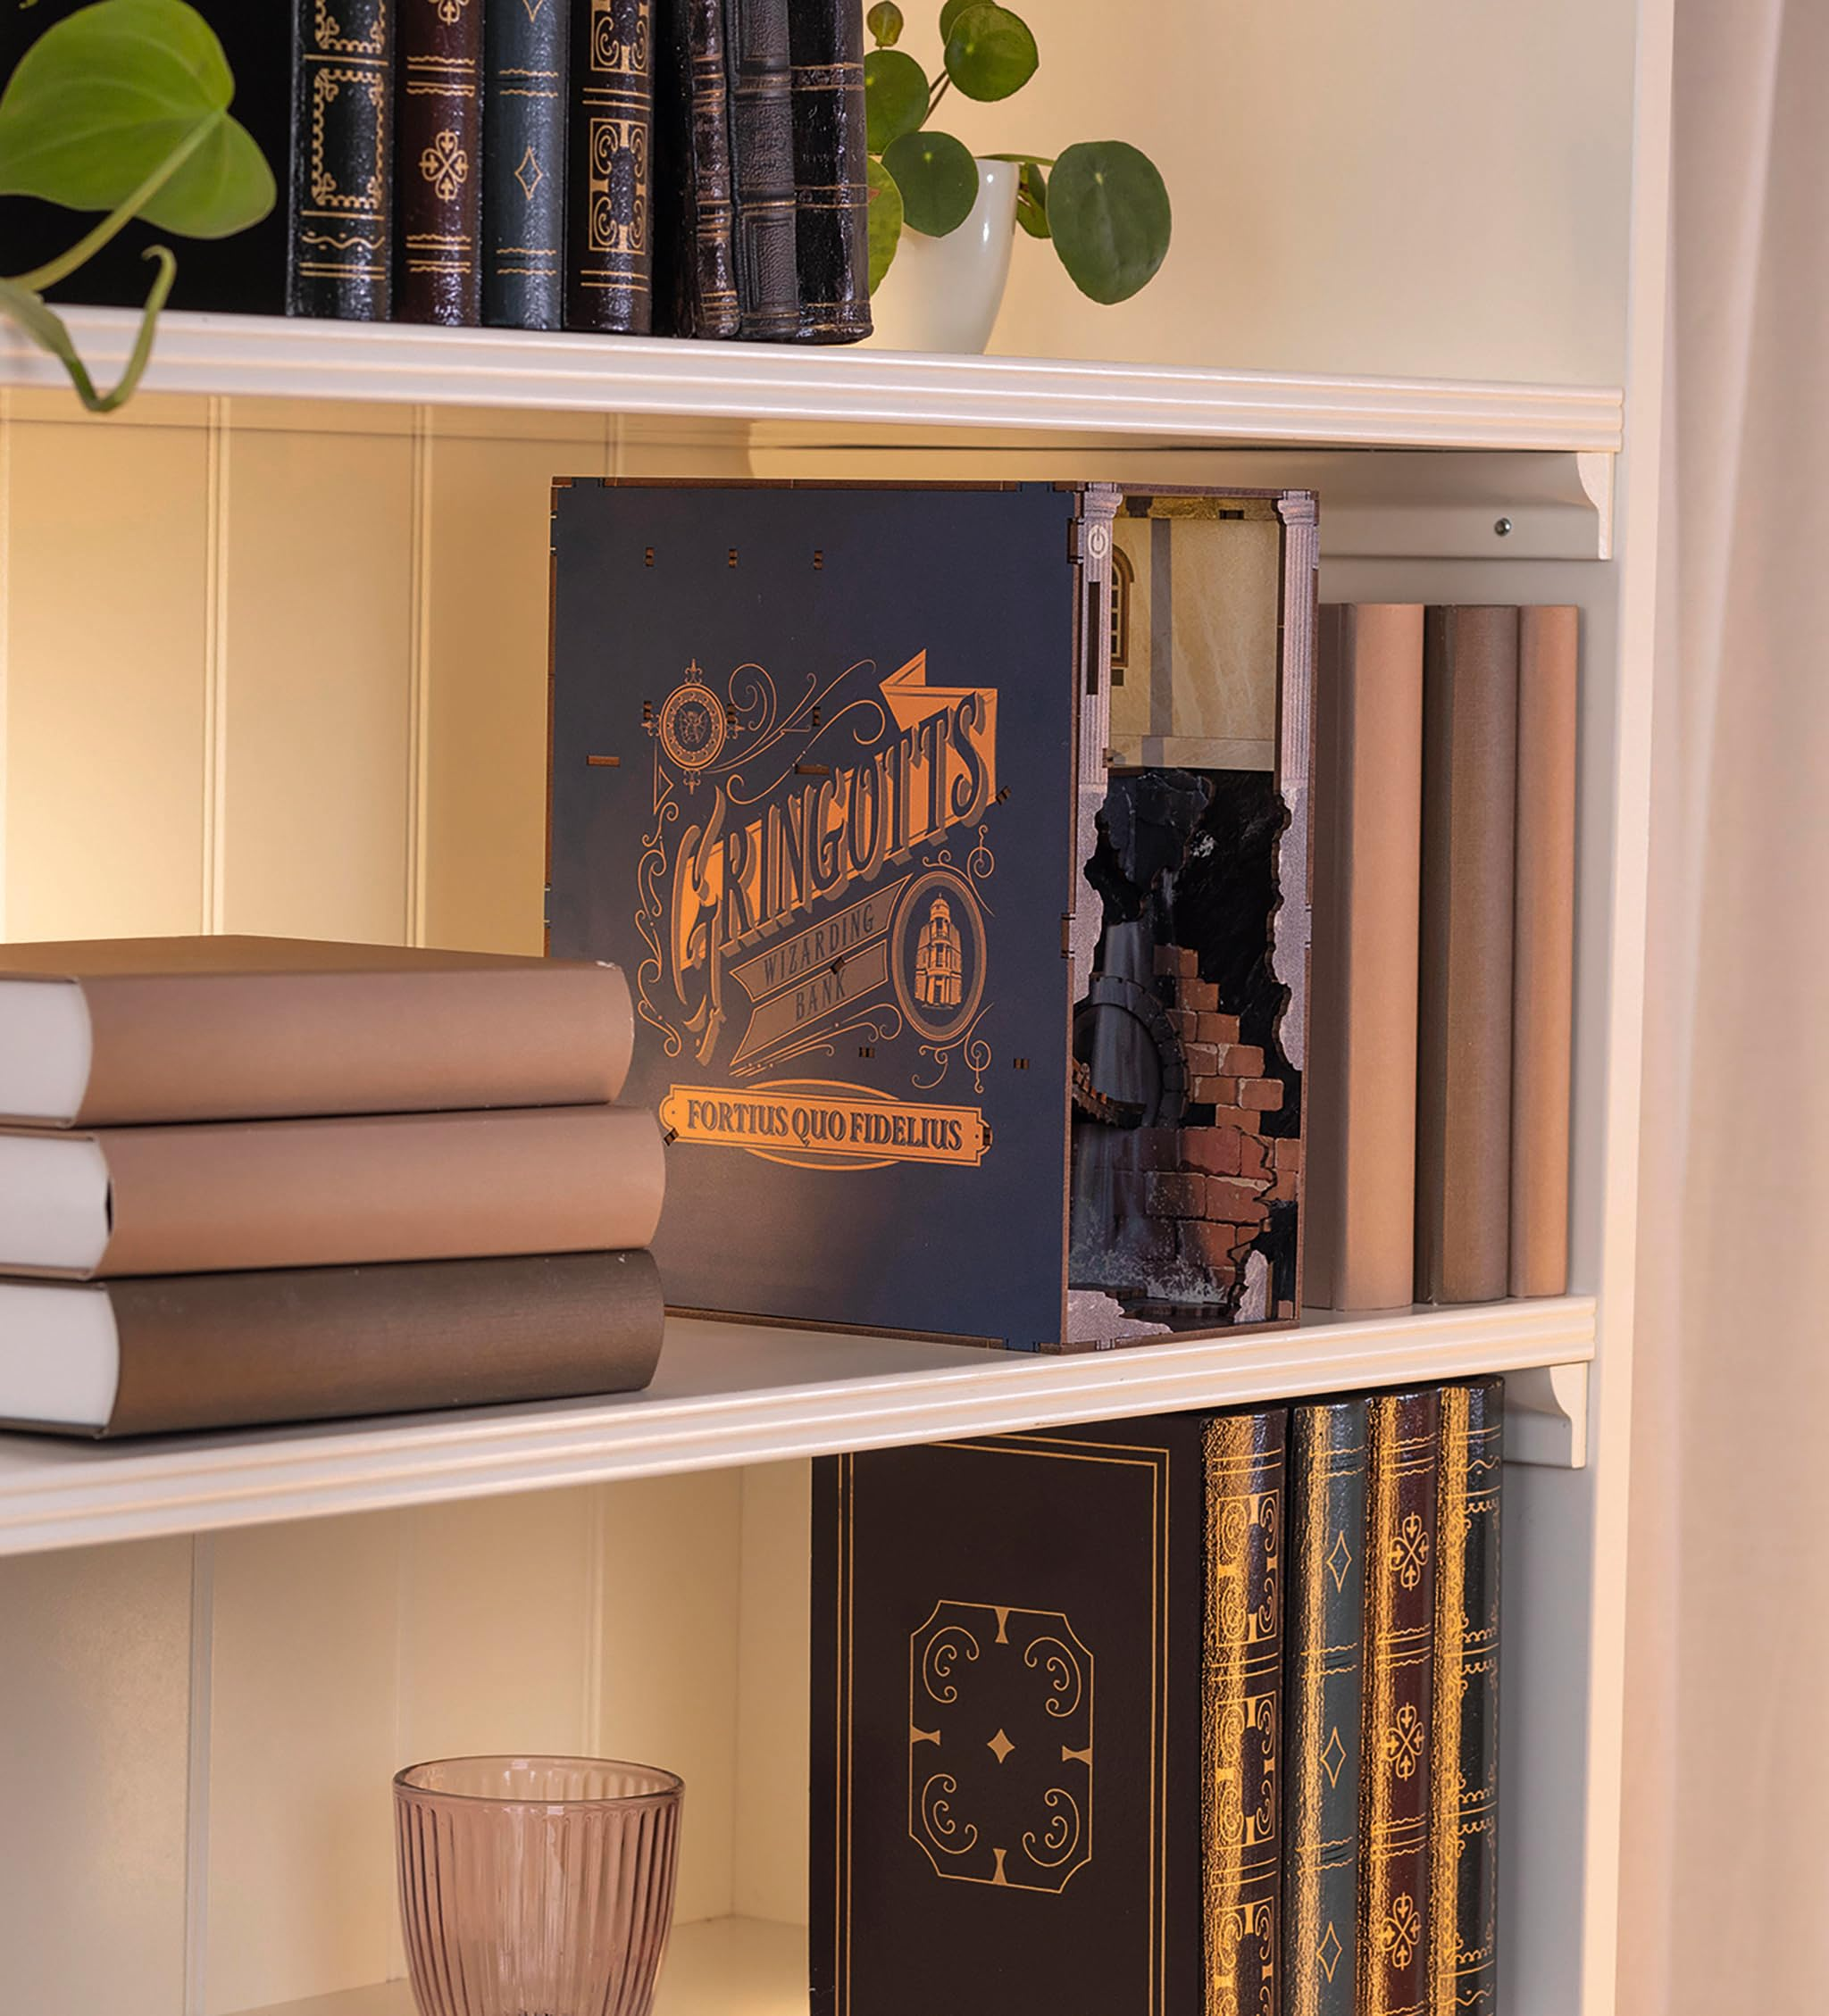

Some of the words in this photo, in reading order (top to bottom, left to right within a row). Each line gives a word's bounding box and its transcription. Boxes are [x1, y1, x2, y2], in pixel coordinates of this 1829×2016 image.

[672, 691, 989, 1066] GRINGOTTS
[764, 904, 874, 986] WIZARDING
[795, 968, 846, 1020] BANK
[687, 1099, 789, 1137] FORTIUS
[791, 1108, 845, 1148] QUO
[849, 1112, 964, 1151] FIDELIUS
